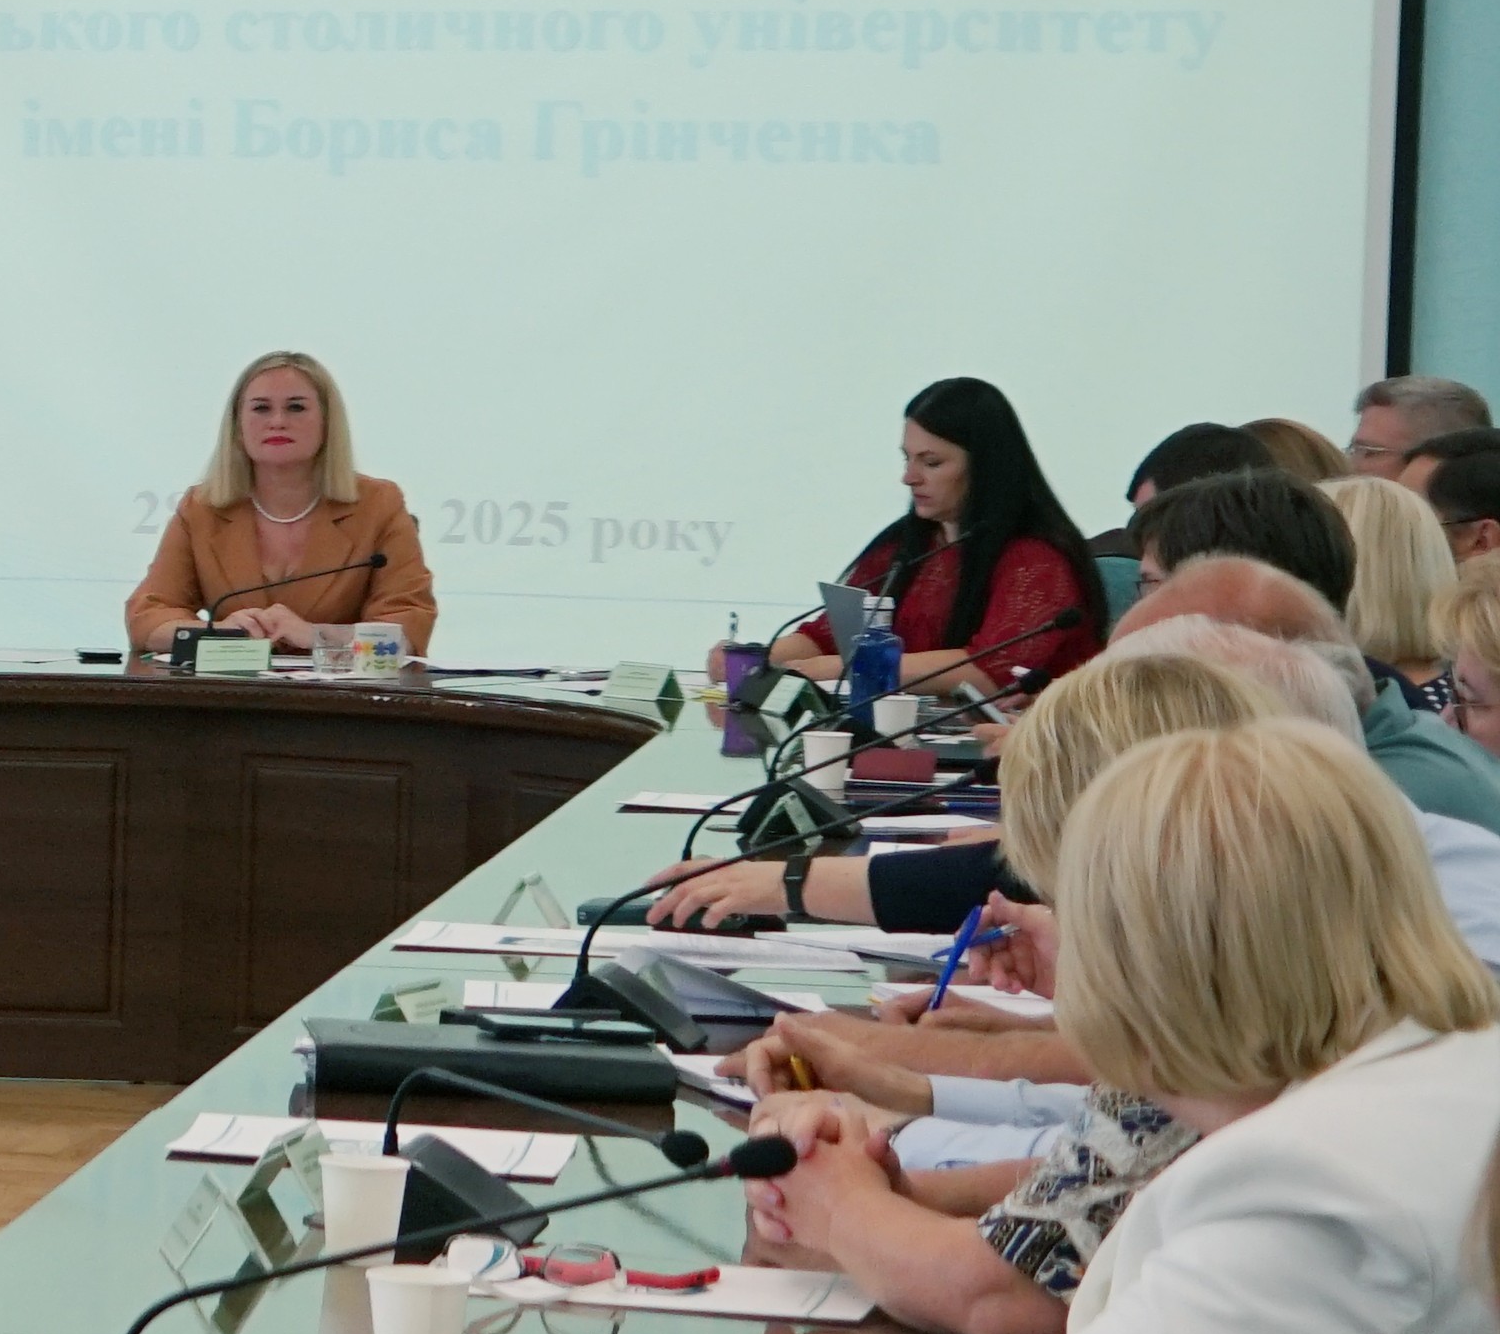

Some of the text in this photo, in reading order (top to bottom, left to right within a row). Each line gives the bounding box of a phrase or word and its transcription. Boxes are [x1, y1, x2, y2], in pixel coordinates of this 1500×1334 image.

[225, 9, 666, 55] столичного
[22, 97, 941, 178] імені Бориса Грінченка
[437, 499, 572, 547] 2025
[588, 515, 734, 566] року
